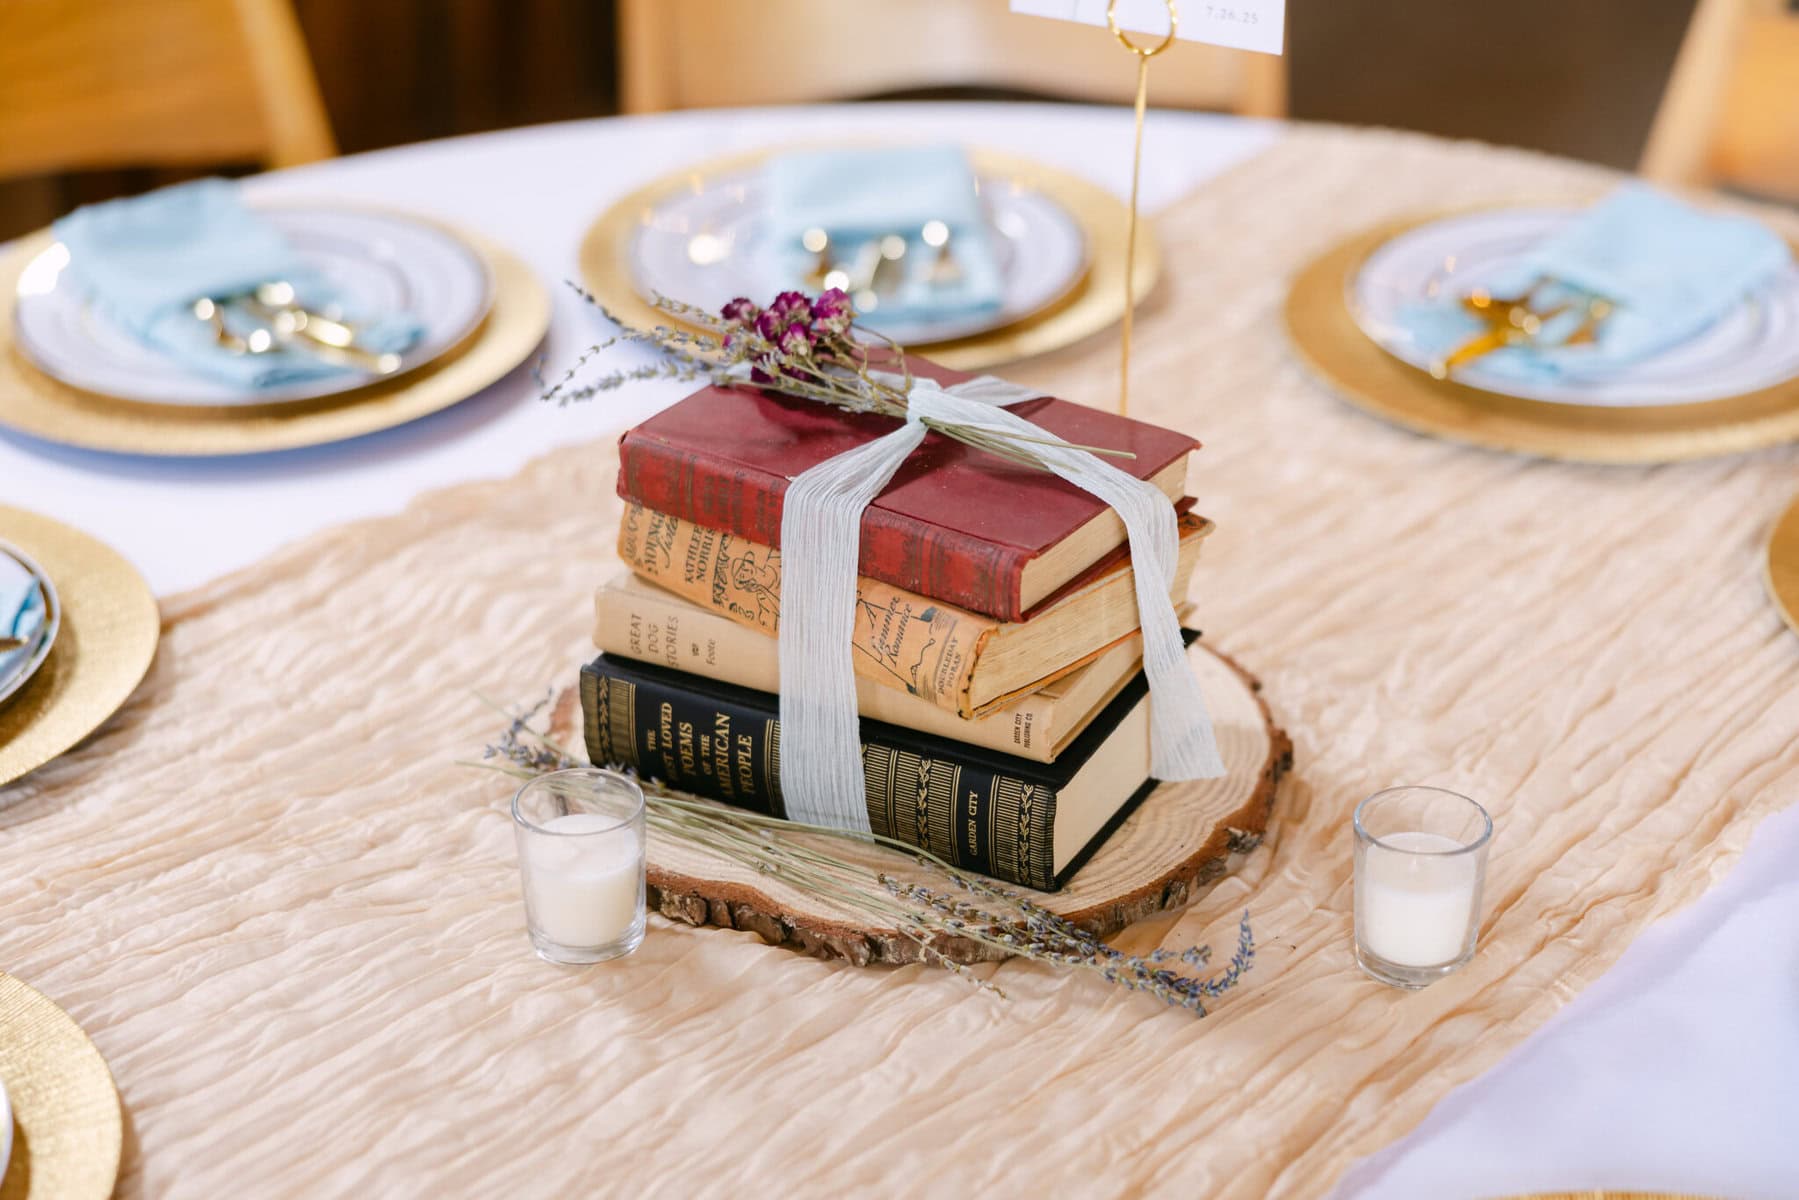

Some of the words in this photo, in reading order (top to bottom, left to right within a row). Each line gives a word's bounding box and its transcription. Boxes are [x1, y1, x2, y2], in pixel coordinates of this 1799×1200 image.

[696, 527, 715, 581] NORRIS
[630, 613, 642, 655] GREAT
[864, 602, 877, 629] A
[871, 596, 901, 663] Summer
[886, 603, 913, 667] Romance
[647, 623, 659, 654] DOG
[665, 615, 679, 668] STORIES
[937, 635, 958, 695] DOUBLEDAY
[948, 653, 962, 688] DORAN
[661, 702, 673, 749] LOVED
[1014, 713, 1022, 725] CITY
[646, 729, 657, 752] THE
[679, 721, 696, 776] POEMS
[701, 734, 711, 758] THE
[715, 712, 735, 798] AMERICAN
[661, 752, 678, 781] EST
[701, 761, 712, 776] OF
[737, 734, 755, 795] PEOPLE
[968, 790, 979, 816] CITY
[968, 819, 978, 856] GARDEN
